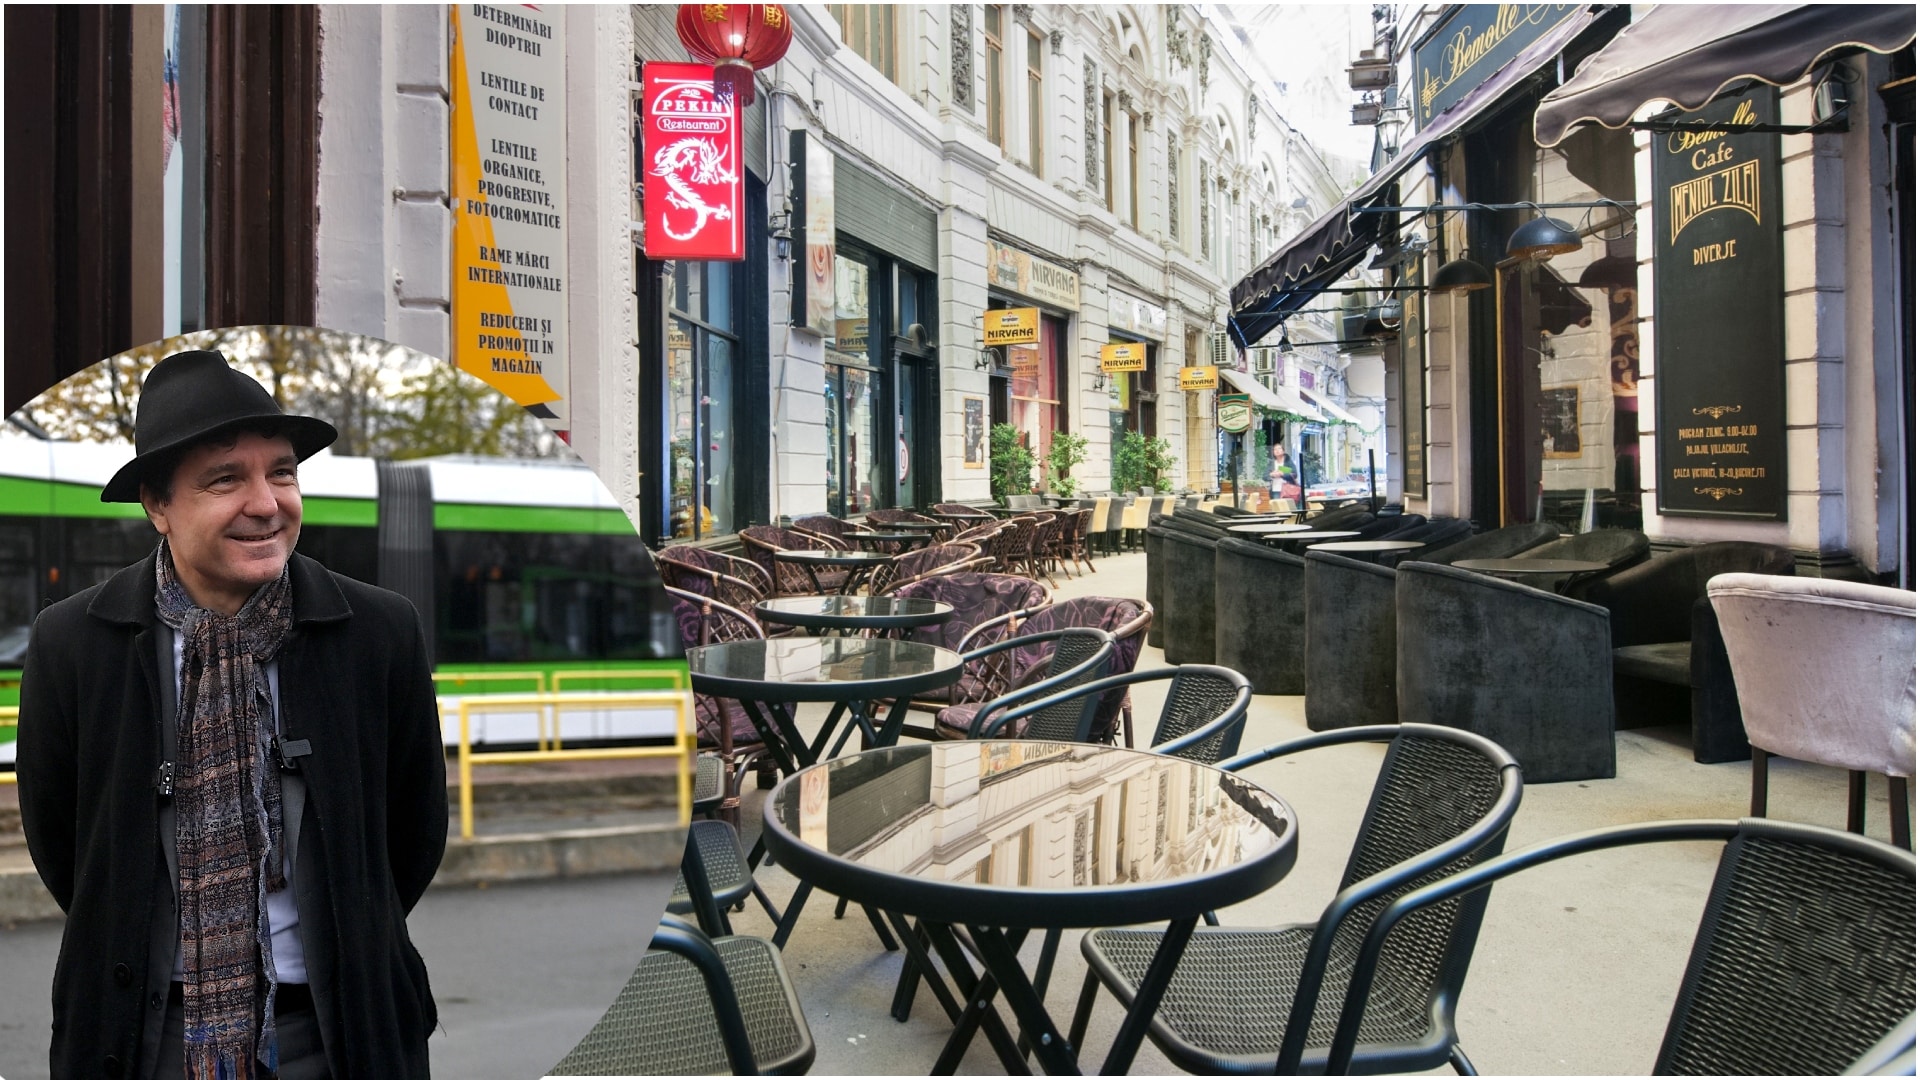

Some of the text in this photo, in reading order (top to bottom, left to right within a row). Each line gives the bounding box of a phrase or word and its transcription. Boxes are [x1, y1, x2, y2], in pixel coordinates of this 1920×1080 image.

[473, 3, 552, 39] DETERMINĂRI
[486, 27, 541, 57] DIOPTRII
[480, 71, 545, 102] LENTILE DE
[488, 95, 539, 120] CONTACT
[662, 99, 723, 113] PEKIN
[662, 118, 720, 131] Restaurant
[491, 138, 537, 162] LENTILE
[1691, 141, 1734, 170] Cafe
[483, 159, 546, 186] ORGANICE,
[478, 180, 556, 210] PROGRESIVE,
[1673, 163, 1756, 235] MENIUL ZILEI
[467, 199, 561, 230] FOTOCROMATICE
[479, 246, 550, 269] RAME MĂRCI
[1692, 239, 1737, 266] DIVERSE
[468, 266, 562, 292] INTERNATIONALE
[1031, 260, 1075, 295] NIRVANA
[480, 312, 538, 331] REDUCERI
[987, 327, 1034, 339] NIRVANA
[478, 334, 539, 357] PROMOȚII
[491, 357, 542, 374] MAGAZIN
[1103, 358, 1142, 367] NIRVANA
[1679, 428, 1704, 440] PROGRAM
